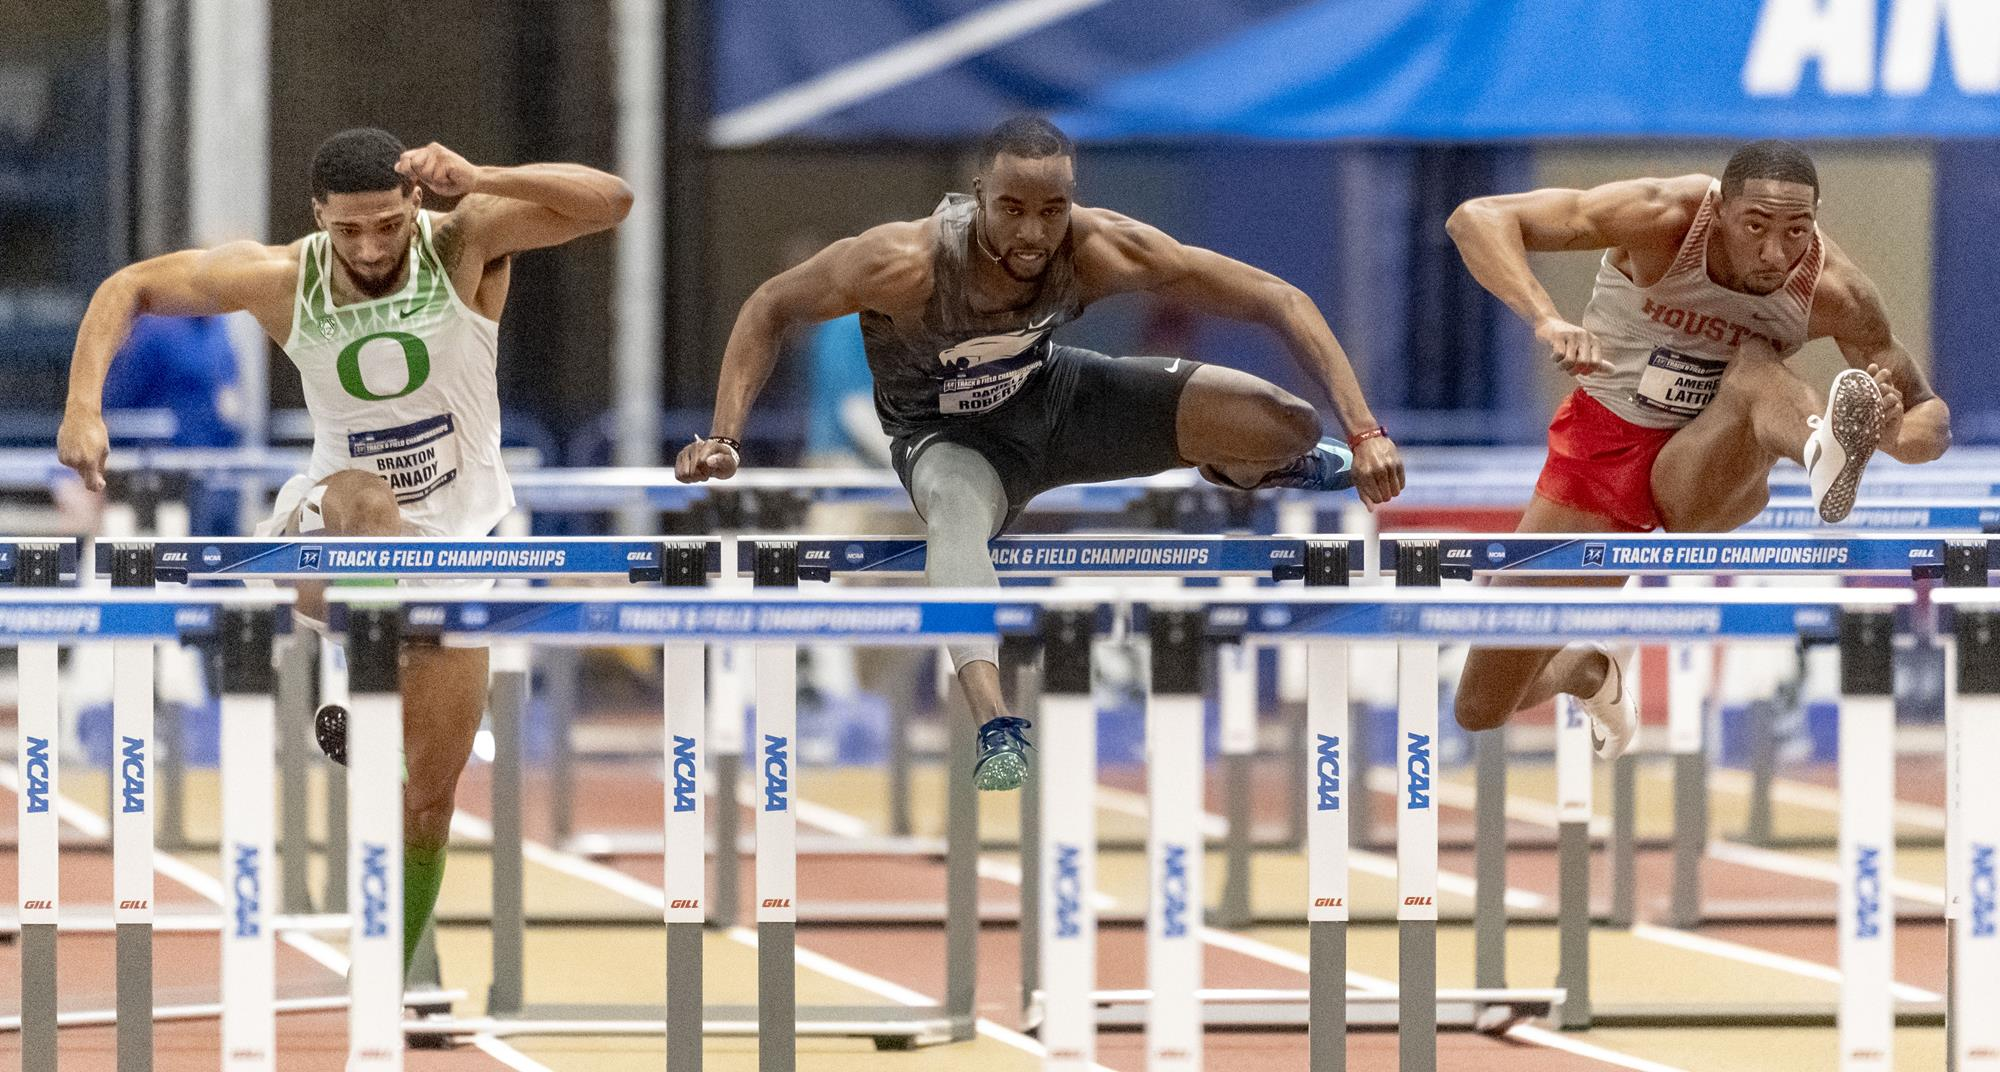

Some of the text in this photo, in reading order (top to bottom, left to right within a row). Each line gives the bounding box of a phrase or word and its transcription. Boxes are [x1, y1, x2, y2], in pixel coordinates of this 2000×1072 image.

[336, 331, 431, 401] O
[959, 381, 1023, 410] ROBERT
[377, 447, 435, 471] BRAXTON
[162, 552, 188, 561] GILL
[203, 554, 222, 562] NCAA
[328, 550, 566, 566] TRACK & FIELD CHAMPIONSHIPS
[626, 551, 653, 561] GILL
[805, 550, 831, 559] GILL
[988, 548, 1209, 565] ACK & FIELD CHAMPIONSHIPS
[1269, 550, 1296, 558] GILL
[1446, 549, 1472, 558] GILL
[1612, 547, 1848, 564] TRACK & FIELD CHAMPIONSHIPS
[1908, 549, 1935, 558] GILL
[27, 736, 49, 814] NCAA
[122, 736, 145, 814] NCAA
[673, 735, 696, 813] NCAA
[764, 734, 787, 812] NCAA
[1316, 734, 1340, 812] NCAA
[1407, 732, 1430, 810] NCAA
[24, 900, 53, 909] GILL
[119, 900, 148, 909] GILL
[670, 899, 699, 909] GILL
[762, 898, 791, 908] GILL
[1314, 897, 1343, 907] GILL
[1404, 896, 1433, 906] GILL
